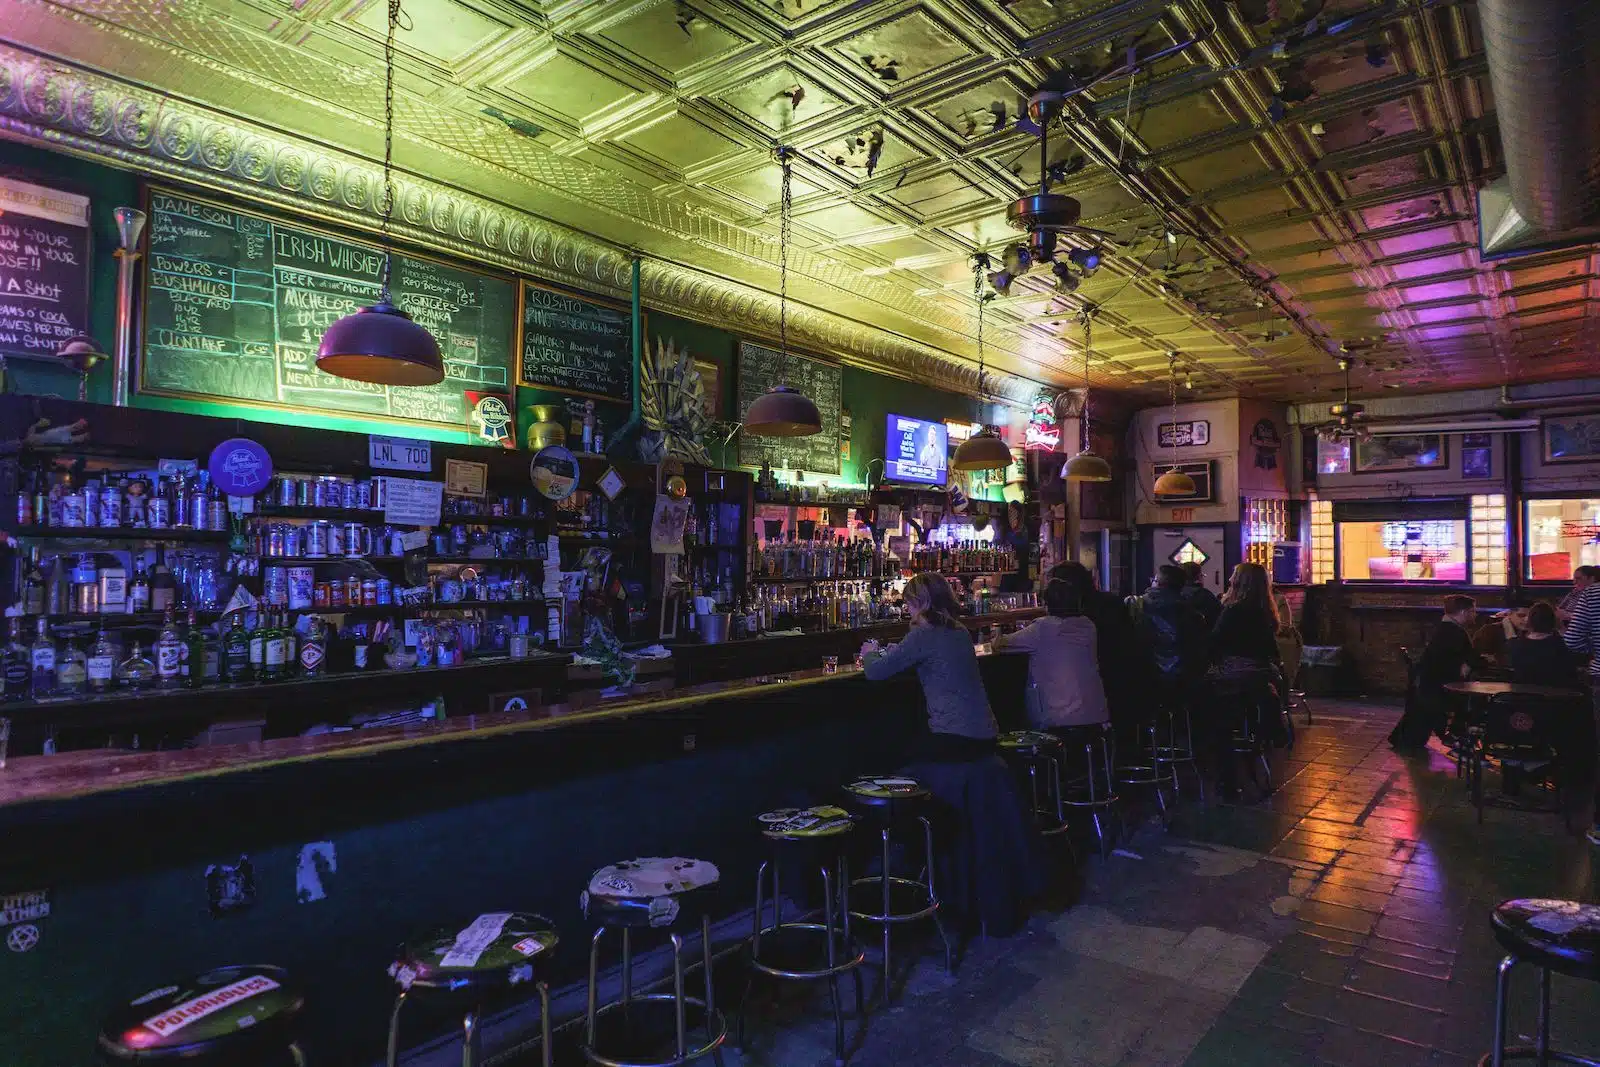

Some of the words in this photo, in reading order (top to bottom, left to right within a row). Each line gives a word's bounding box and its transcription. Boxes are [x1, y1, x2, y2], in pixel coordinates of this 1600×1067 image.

[152, 194, 232, 226] JAMESON
[23, 227, 72, 248] YOUR
[24, 244, 39, 256] IN
[43, 247, 79, 266] YOUR
[276, 233, 325, 265] IRISH
[327, 243, 385, 277] WHISKEY
[156, 256, 213, 277] POWERS
[7, 277, 21, 292] A
[152, 272, 230, 298] BUSHMILLS
[280, 270, 316, 287] BEER
[531, 290, 582, 313] ROSATO
[159, 329, 226, 353] CLONTARF
[283, 348, 307, 363] ADD
[443, 361, 468, 379] DEW
[523, 362, 538, 371] LES
[286, 371, 319, 387] NEAT
[373, 444, 398, 463] LNL
[405, 447, 428, 465] 700
[1171, 507, 1193, 523] EXIT
